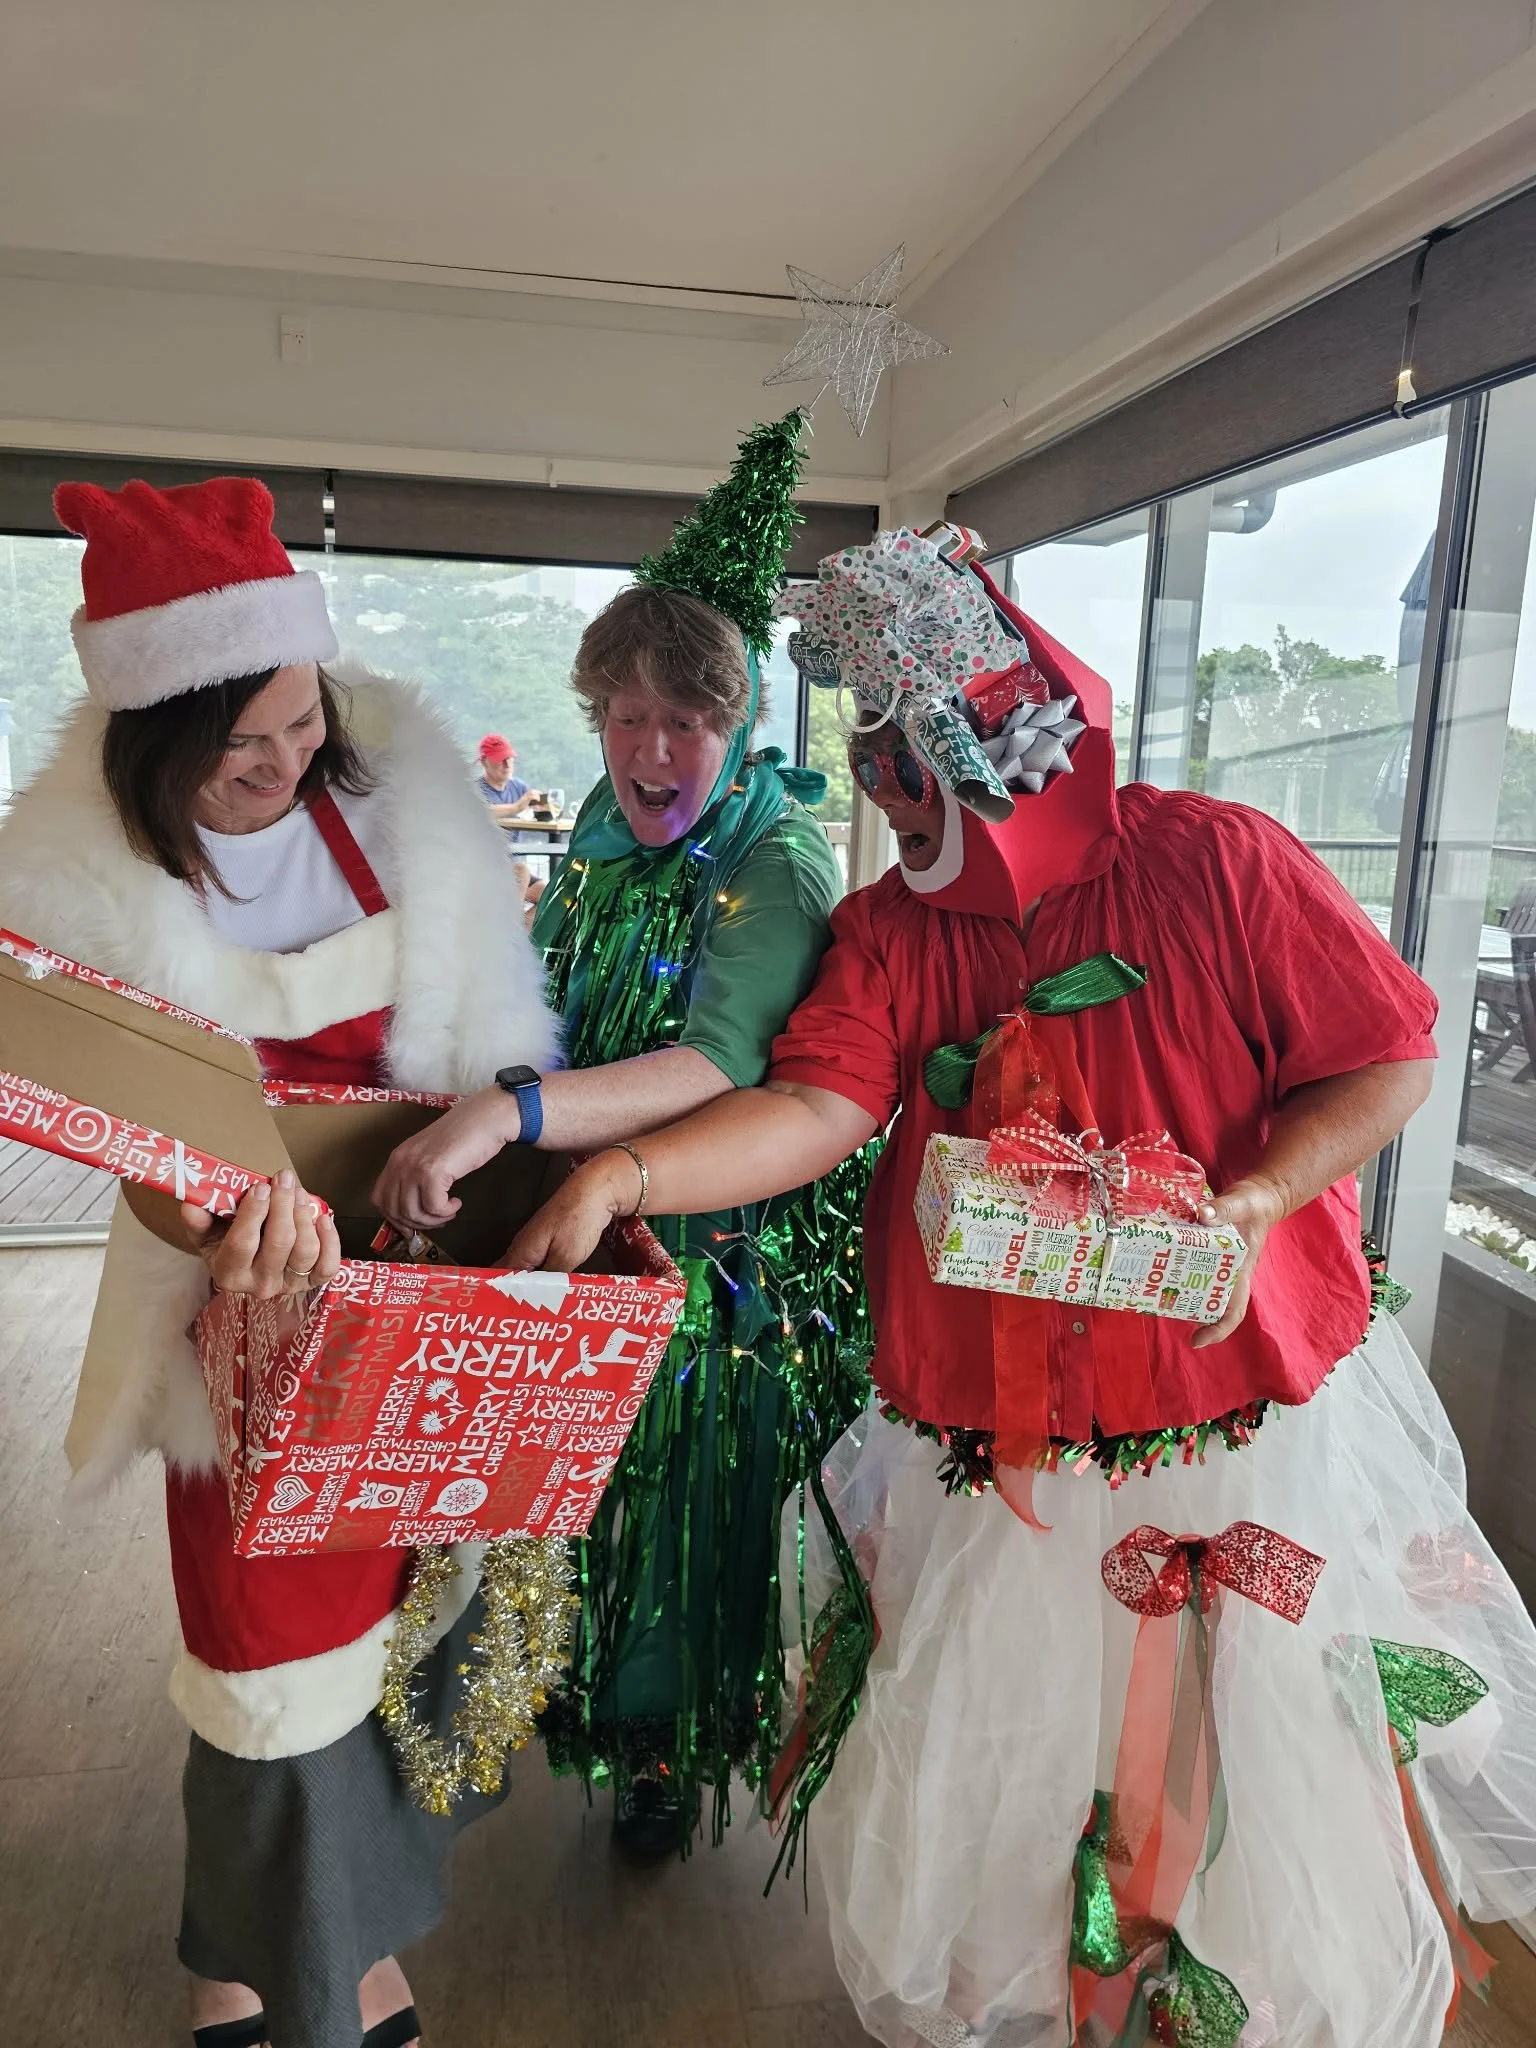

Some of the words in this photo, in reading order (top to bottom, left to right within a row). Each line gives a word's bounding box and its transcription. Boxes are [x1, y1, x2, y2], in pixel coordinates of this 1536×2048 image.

[969, 1171, 1018, 1190] PEACE
[976, 1184, 1025, 1198] JOLLY
[951, 1198, 1030, 1226] Christmas
[1034, 1207, 1068, 1219] HOLLY
[1033, 1217, 1068, 1231] JOLLY
[1177, 1228, 1210, 1240] HOLLY
[967, 1238, 1008, 1258] LOVE
[1024, 1230, 1045, 1267] FAMILY
[1044, 1231, 1077, 1247] MERRY
[1177, 1236, 1211, 1249] JOLLY
[943, 1254, 990, 1268] Christmas
[1001, 1231, 1028, 1280] NOEL
[1038, 1253, 1071, 1273] JOY
[1110, 1256, 1149, 1276] LOVE
[1167, 1248, 1189, 1284] FAMILY
[1189, 1250, 1222, 1265] MERRY
[947, 1266, 980, 1279] Wishes
[1143, 1248, 1172, 1298] NOEL
[1181, 1271, 1213, 1292] JOY
[390, 1279, 428, 1290] MERRY
[576, 1285, 661, 1305] CHRISTMAS!
[384, 1296, 421, 1306] MERRY
[566, 1299, 657, 1328] MERRY
[413, 1311, 573, 1343] CHRISTMAS!
[396, 1337, 565, 1380] MERRY
[628, 1331, 669, 1391] MERRY
[338, 1309, 408, 1441] CHRISTMAS!
[531, 1384, 617, 1403] CHRISTMAS!
[371, 1374, 411, 1437] MERRY
[392, 1375, 426, 1437] CHRISTMAS!
[522, 1398, 611, 1423] MERRY
[449, 1380, 511, 1476] MERRY
[481, 1383, 533, 1476] CHRISTMAS!
[542, 1421, 562, 1450] MERRY
[289, 1443, 363, 1455] CHRISTMAS!
[365, 1437, 457, 1453] CHRISTMAS!
[281, 1453, 360, 1473] MERRY
[356, 1451, 453, 1473] MERRY
[542, 1455, 567, 1490] MERRY
[312, 1473, 341, 1513] MERRY
[326, 1471, 352, 1513] CHRISTMAS!
[397, 1479, 423, 1517] MERRY
[523, 1493, 549, 1525] MERRY
[256, 1513, 334, 1527] CHRISTMAS!
[390, 1519, 477, 1532] CHRISTMAS!
[248, 1525, 330, 1546] MERRY
[379, 1529, 471, 1548] MERRY
